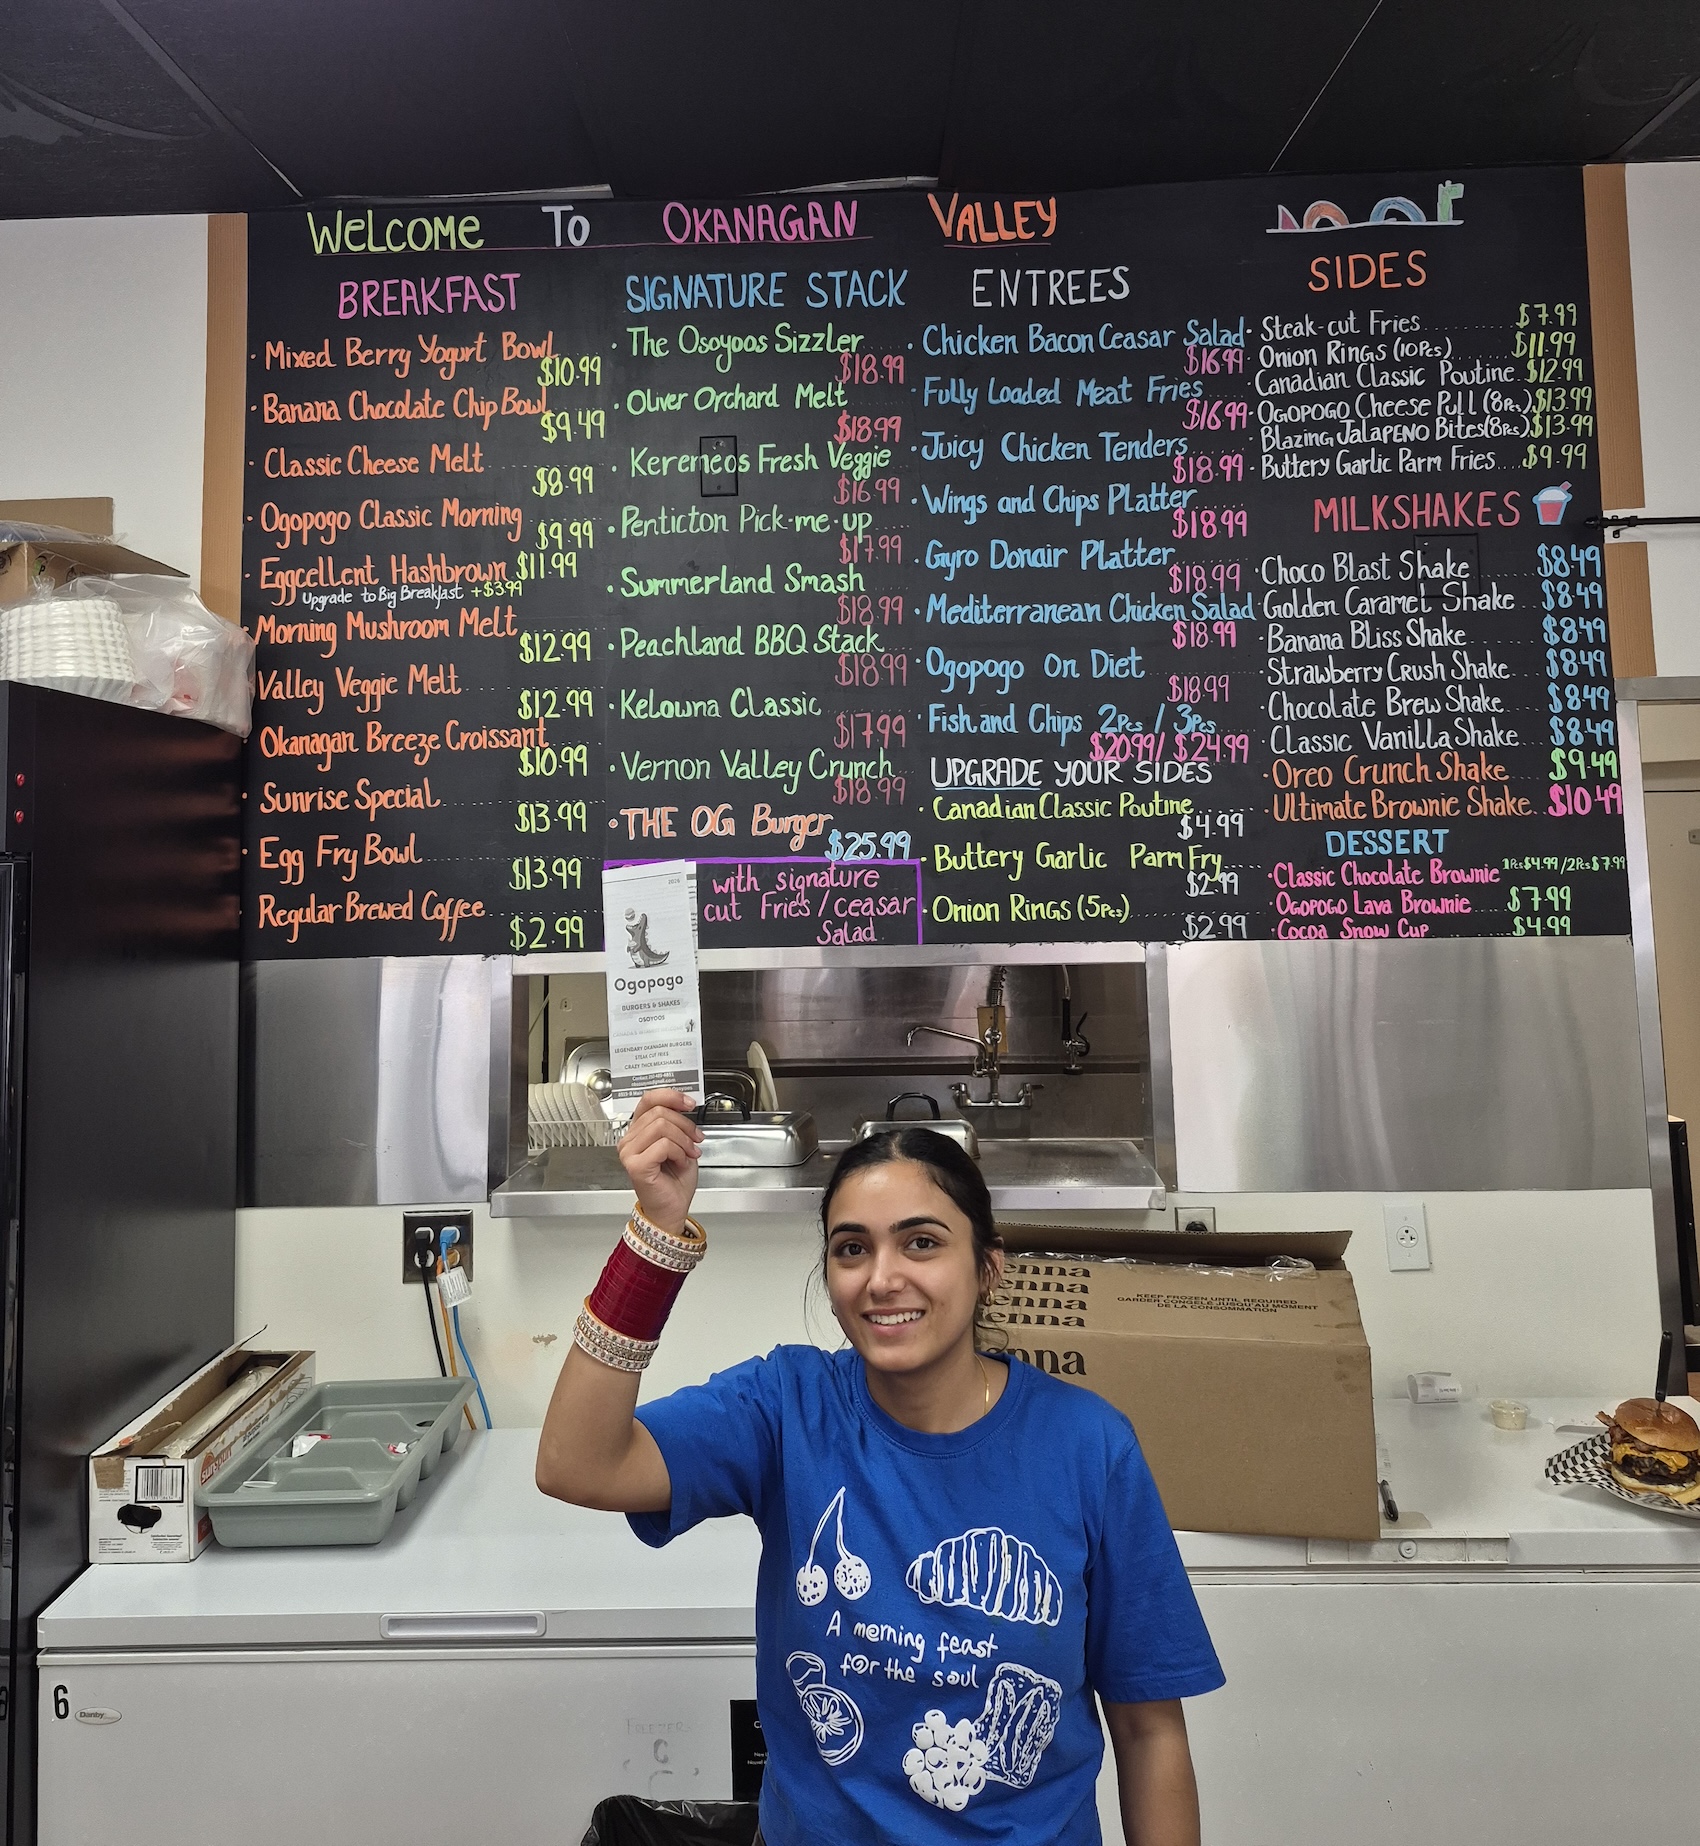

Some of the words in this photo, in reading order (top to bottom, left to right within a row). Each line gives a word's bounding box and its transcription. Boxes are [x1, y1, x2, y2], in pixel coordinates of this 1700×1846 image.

[662, 200, 858, 243] OKANAGAN
[927, 192, 1057, 243] VALLEY
[972, 265, 1130, 308] ENTREES
[1308, 249, 1428, 292] SIDES
[338, 273, 521, 320] BREAKFAST
[625, 271, 787, 314] SIGNATURE
[805, 268, 908, 309] STACK
[1260, 314, 1360, 343] Steak-cut
[1369, 309, 1421, 336] Fries
[1516, 302, 1577, 329] $7.99
[265, 337, 336, 370] Mixed
[345, 336, 411, 379] Berry
[417, 331, 487, 381] Yogurt
[501, 330, 559, 360] Bowl
[626, 325, 670, 358] The
[677, 323, 768, 375] Osoyoos
[774, 321, 865, 354] Sizzler
[536, 355, 602, 388] $10.99
[834, 350, 905, 385] $18.99
[263, 392, 342, 426] Banana
[348, 388, 446, 422] Chocolate
[452, 386, 499, 432] Chip
[500, 384, 552, 416] Bowl
[626, 388, 688, 416] Oliver
[693, 382, 780, 413] Orchard
[794, 380, 848, 410] Melt
[540, 409, 606, 444] $9.49
[833, 409, 902, 445] $18.99
[264, 446, 342, 479] Classic
[347, 444, 420, 476] Cheese
[429, 441, 485, 474] Melt
[921, 430, 984, 471] Juicy
[1000, 430, 1092, 462] Chicken
[1098, 428, 1188, 462] Tenders
[1261, 454, 1330, 480] Buttery
[1335, 447, 1392, 479] Garlic
[1399, 447, 1442, 474] Parm
[1450, 445, 1496, 472] Fries
[1521, 442, 1588, 469] $9.99
[532, 465, 594, 498] $8.99
[1172, 451, 1245, 484] $18.99
[921, 484, 988, 526] Wings
[997, 484, 1036, 514] and
[1042, 484, 1100, 527] Chips
[1107, 482, 1199, 516] Platter
[1313, 490, 1521, 533] MILKSHAKES
[260, 501, 351, 550] Ogopogo
[359, 499, 433, 531] Classic
[441, 497, 523, 543] Morning
[535, 519, 594, 551] $9.99
[515, 551, 578, 581] $11.99
[924, 539, 979, 582] Gyro
[989, 538, 1069, 570] Donair
[1080, 537, 1177, 571] Platter
[260, 554, 380, 607] Eggcellent
[390, 552, 509, 585] Hashbrown
[620, 563, 775, 598] Summerland
[784, 562, 866, 594] Smash
[1167, 561, 1241, 595] $18.99
[302, 588, 353, 612] Upgrade
[360, 586, 376, 602] to
[378, 586, 397, 609] Big
[400, 583, 464, 609] Breakfast
[836, 592, 904, 627] $18.99
[620, 625, 745, 659] Peachland
[754, 624, 808, 656] BBQ
[813, 623, 886, 654] Stack
[1267, 622, 1344, 654] Banana
[1351, 619, 1402, 650] Bliss
[1406, 616, 1467, 648] Shake
[1542, 613, 1606, 646] $8.49
[834, 652, 908, 687] $18.99
[1268, 689, 1376, 721] Chocolate
[1386, 685, 1441, 718] Brew
[1445, 683, 1505, 715] Shake
[1547, 682, 1611, 714] $8.49
[930, 757, 1044, 788] UPGRADE
[1132, 761, 1213, 785] SIDES
[1272, 758, 1333, 789] Oreo
[1344, 753, 1432, 786] Crunch
[1436, 751, 1510, 782] Shake
[1548, 748, 1619, 782] $9.49
[619, 806, 679, 841] THE
[690, 803, 736, 838] OG
[751, 802, 834, 852] Burger
[824, 828, 912, 861] $25.99
[1325, 828, 1449, 858] DESSERT
[934, 841, 1024, 882] Buttery
[1035, 842, 1108, 871] Garlic
[1130, 842, 1185, 869] Parm
[1188, 844, 1223, 881] Fry
[1273, 860, 1336, 889] Classic
[1340, 858, 1424, 887] Chocolate
[1429, 859, 1501, 886] Brownie
[712, 863, 760, 895] with
[775, 860, 881, 906] signature
[258, 893, 344, 944] Regular
[345, 889, 414, 922] Brewed
[420, 889, 486, 943] Coffee
[702, 899, 742, 922] cut
[759, 890, 811, 921] Fries
[833, 895, 917, 920] ceasar
[509, 915, 585, 951] $2.99
[815, 917, 877, 947] Salad
[614, 975, 684, 995] Ogopogo
[621, 1002, 652, 1012] BURGERS
[658, 999, 681, 1008] SHAKES
[638, 1015, 665, 1023] OSOYOOS
[993, 1294, 1088, 1311] enna
[998, 1278, 1090, 1295] enna
[985, 1311, 1086, 1328] enna
[1190, 1304, 1277, 1313] CONSOMMATION
[826, 1610, 841, 1637] A
[937, 1633, 999, 1663] feast
[840, 1653, 880, 1677] for
[884, 1658, 916, 1684] the
[931, 1663, 980, 1689] soul
[53, 1684, 69, 1719] 6
[79, 1711, 105, 1719] Danby
